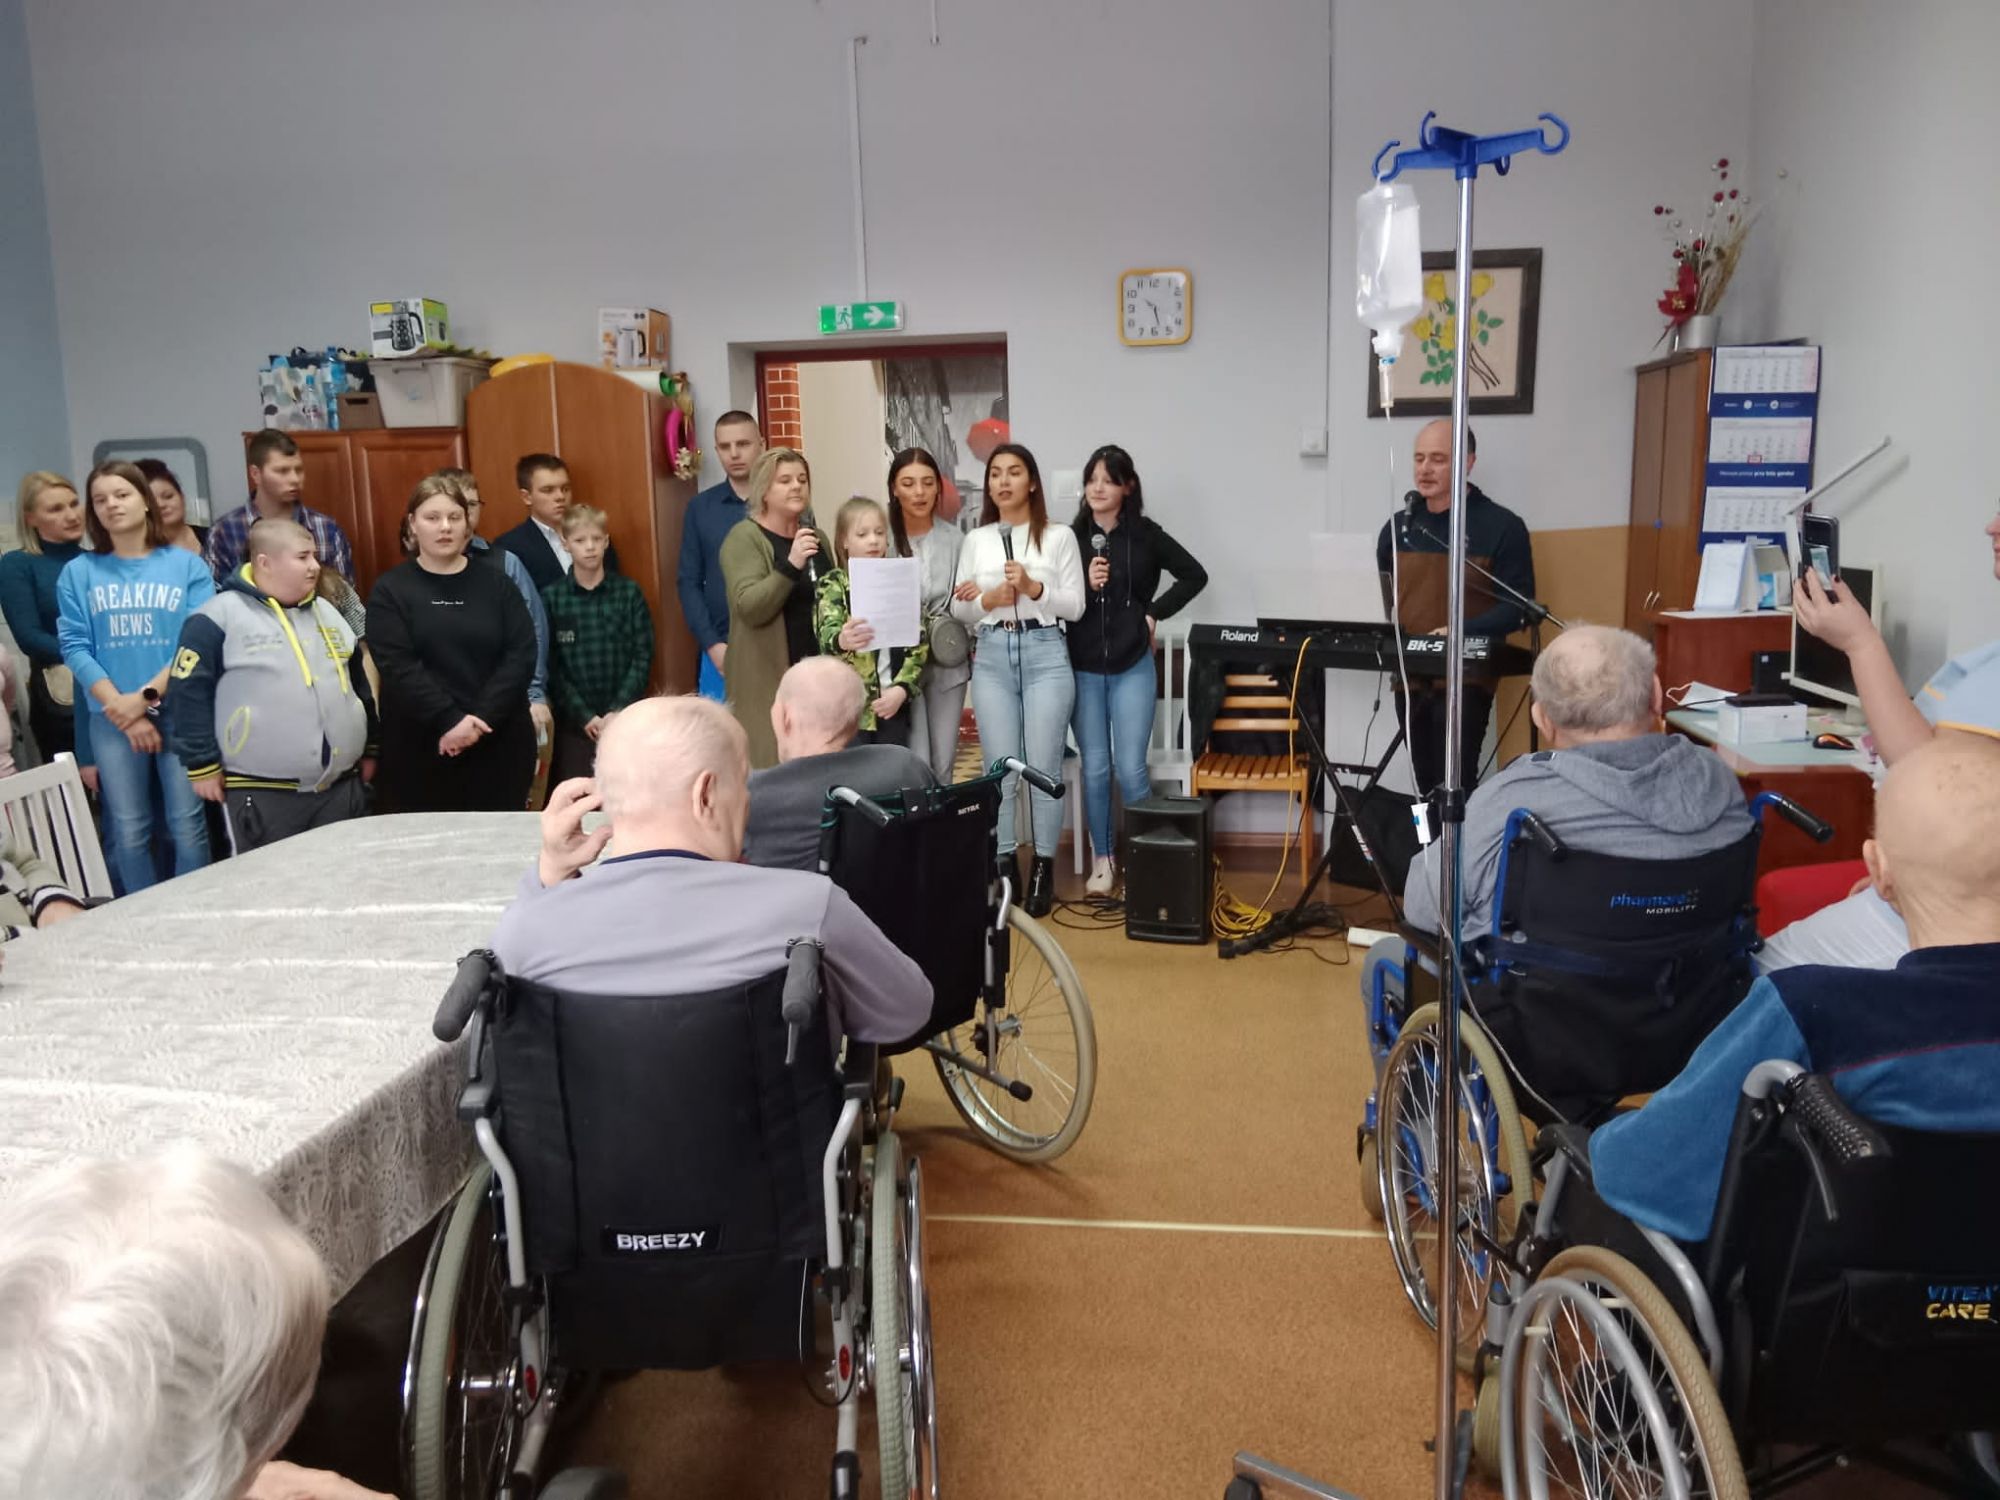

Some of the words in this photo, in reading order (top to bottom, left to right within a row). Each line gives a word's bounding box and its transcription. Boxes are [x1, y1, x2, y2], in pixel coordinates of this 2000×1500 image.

[1149, 279, 1160, 288] 12
[1127, 289, 1137, 299] 10
[1128, 304, 1136, 313] 9
[110, 614, 152, 637] NEWS
[1220, 629, 1259, 643] Roland
[1406, 639, 1446, 653] BK-5
[1646, 904, 1697, 914] MOBILITY
[616, 1230, 706, 1251] BREEZY
[1926, 1303, 1992, 1320] CARE
